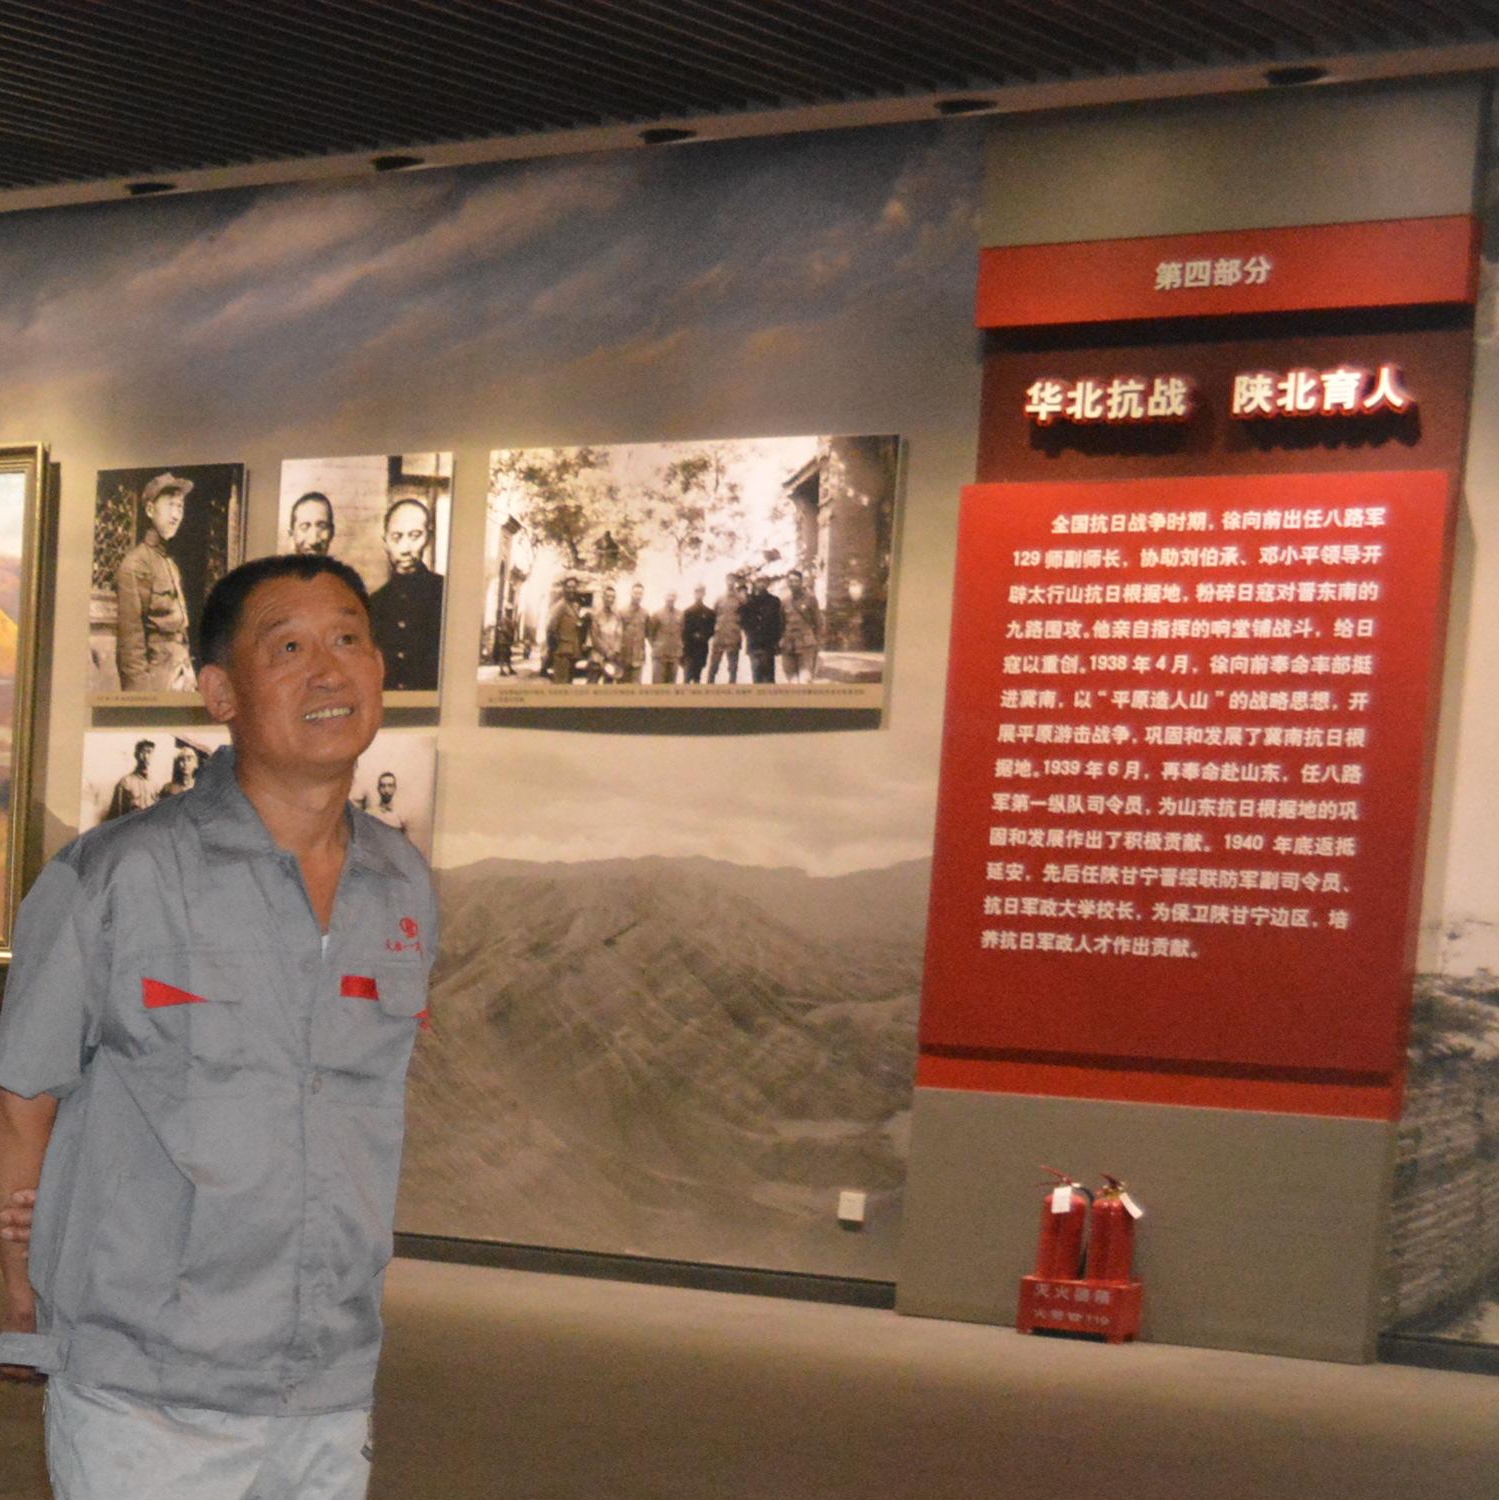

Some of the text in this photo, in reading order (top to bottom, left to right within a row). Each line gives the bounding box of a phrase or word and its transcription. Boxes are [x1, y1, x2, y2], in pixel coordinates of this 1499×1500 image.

[1153, 255, 1272, 290] 第四部分
[1025, 367, 1405, 421] 华北抗战 陕北育人
